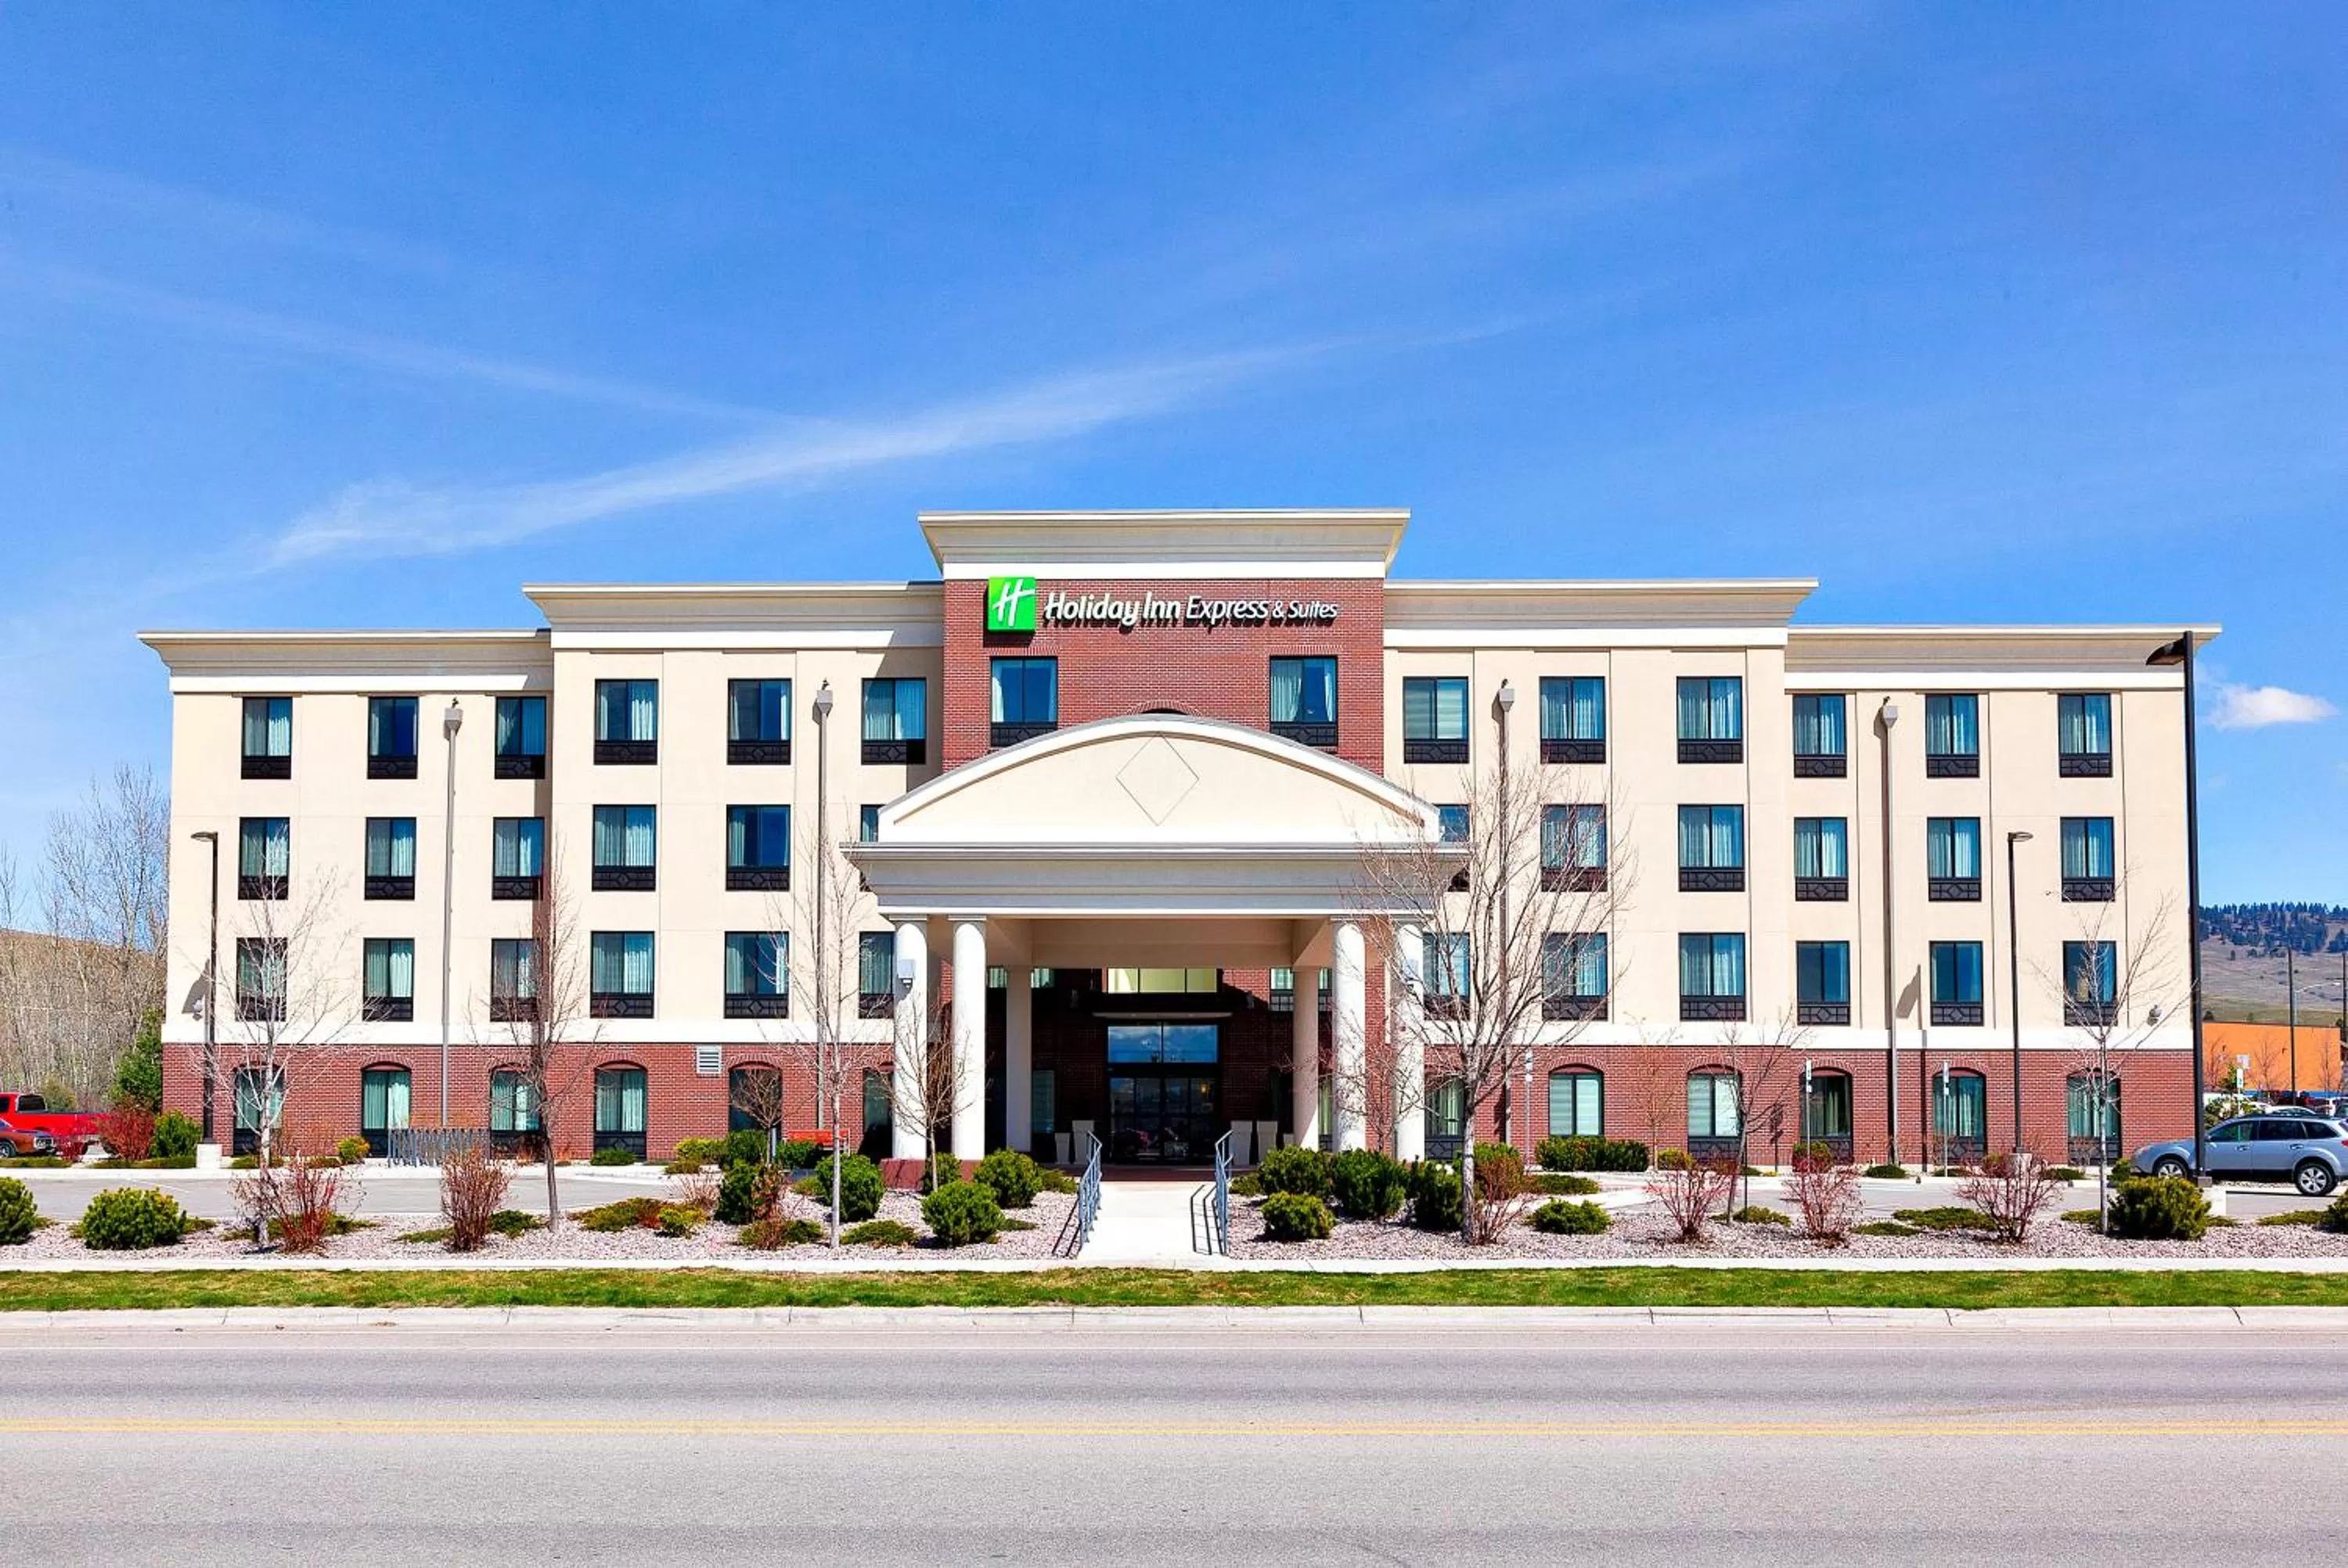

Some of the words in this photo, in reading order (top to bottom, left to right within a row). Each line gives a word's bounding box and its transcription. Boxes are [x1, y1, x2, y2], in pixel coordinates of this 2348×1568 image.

[1044, 592, 1139, 626] Holiday
[1143, 592, 1181, 620] Inn
[1187, 595, 1269, 624] Express
[1272, 601, 1284, 618] &
[1288, 600, 1338, 618] Suites
